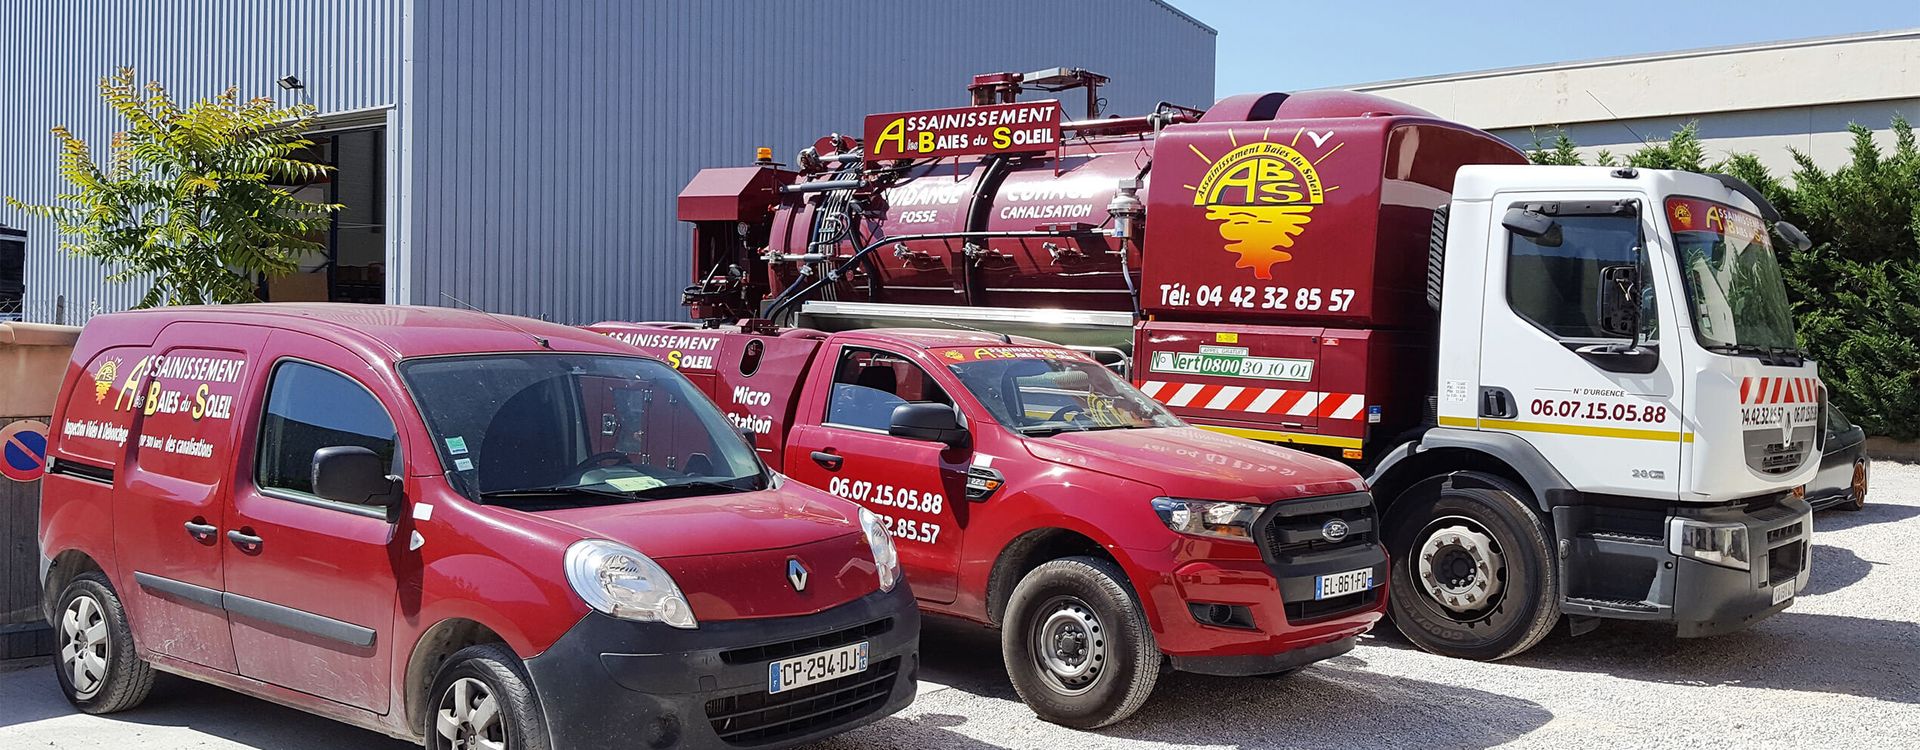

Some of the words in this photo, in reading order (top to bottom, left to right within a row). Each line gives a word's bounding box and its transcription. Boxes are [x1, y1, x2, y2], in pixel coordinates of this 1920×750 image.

[874, 106, 1055, 154] ASSAINISSEMENT
[919, 131, 968, 153] BAIES
[973, 134, 987, 146] du
[992, 127, 1053, 149] SOLEIL
[1197, 145, 1260, 199] Assainissement
[1263, 144, 1290, 158] Baies
[1291, 155, 1304, 167] du
[1302, 167, 1321, 196] Soleil
[899, 209, 938, 224] FOSSE
[1000, 203, 1092, 219] CANALISATION
[1159, 282, 1191, 306] Tél:
[1196, 285, 1223, 307] 04
[1229, 286, 1256, 308] 42
[1261, 287, 1289, 310] 32
[1295, 288, 1322, 311] 85
[1328, 289, 1355, 312] 57
[667, 350, 713, 369] SOLEIL
[1171, 353, 1201, 370] Vert
[1202, 358, 1239, 374] 0800
[1242, 361, 1263, 375] 30
[1266, 362, 1285, 377] 10
[1289, 363, 1308, 378] 01
[114, 354, 245, 412] ASSAINISSEMENT
[1583, 388, 1625, 398] D'URGENCE
[143, 380, 180, 416] BAIES
[180, 394, 192, 412] du
[192, 383, 233, 420] SOLEIL
[733, 385, 771, 407] Micro
[727, 412, 773, 434] Station
[1530, 399, 1667, 424] 06.07.15.05.88
[165, 434, 176, 452] des
[829, 476, 943, 515] 06.07.15.05.88
[784, 652, 857, 687] CP-294-DJ
